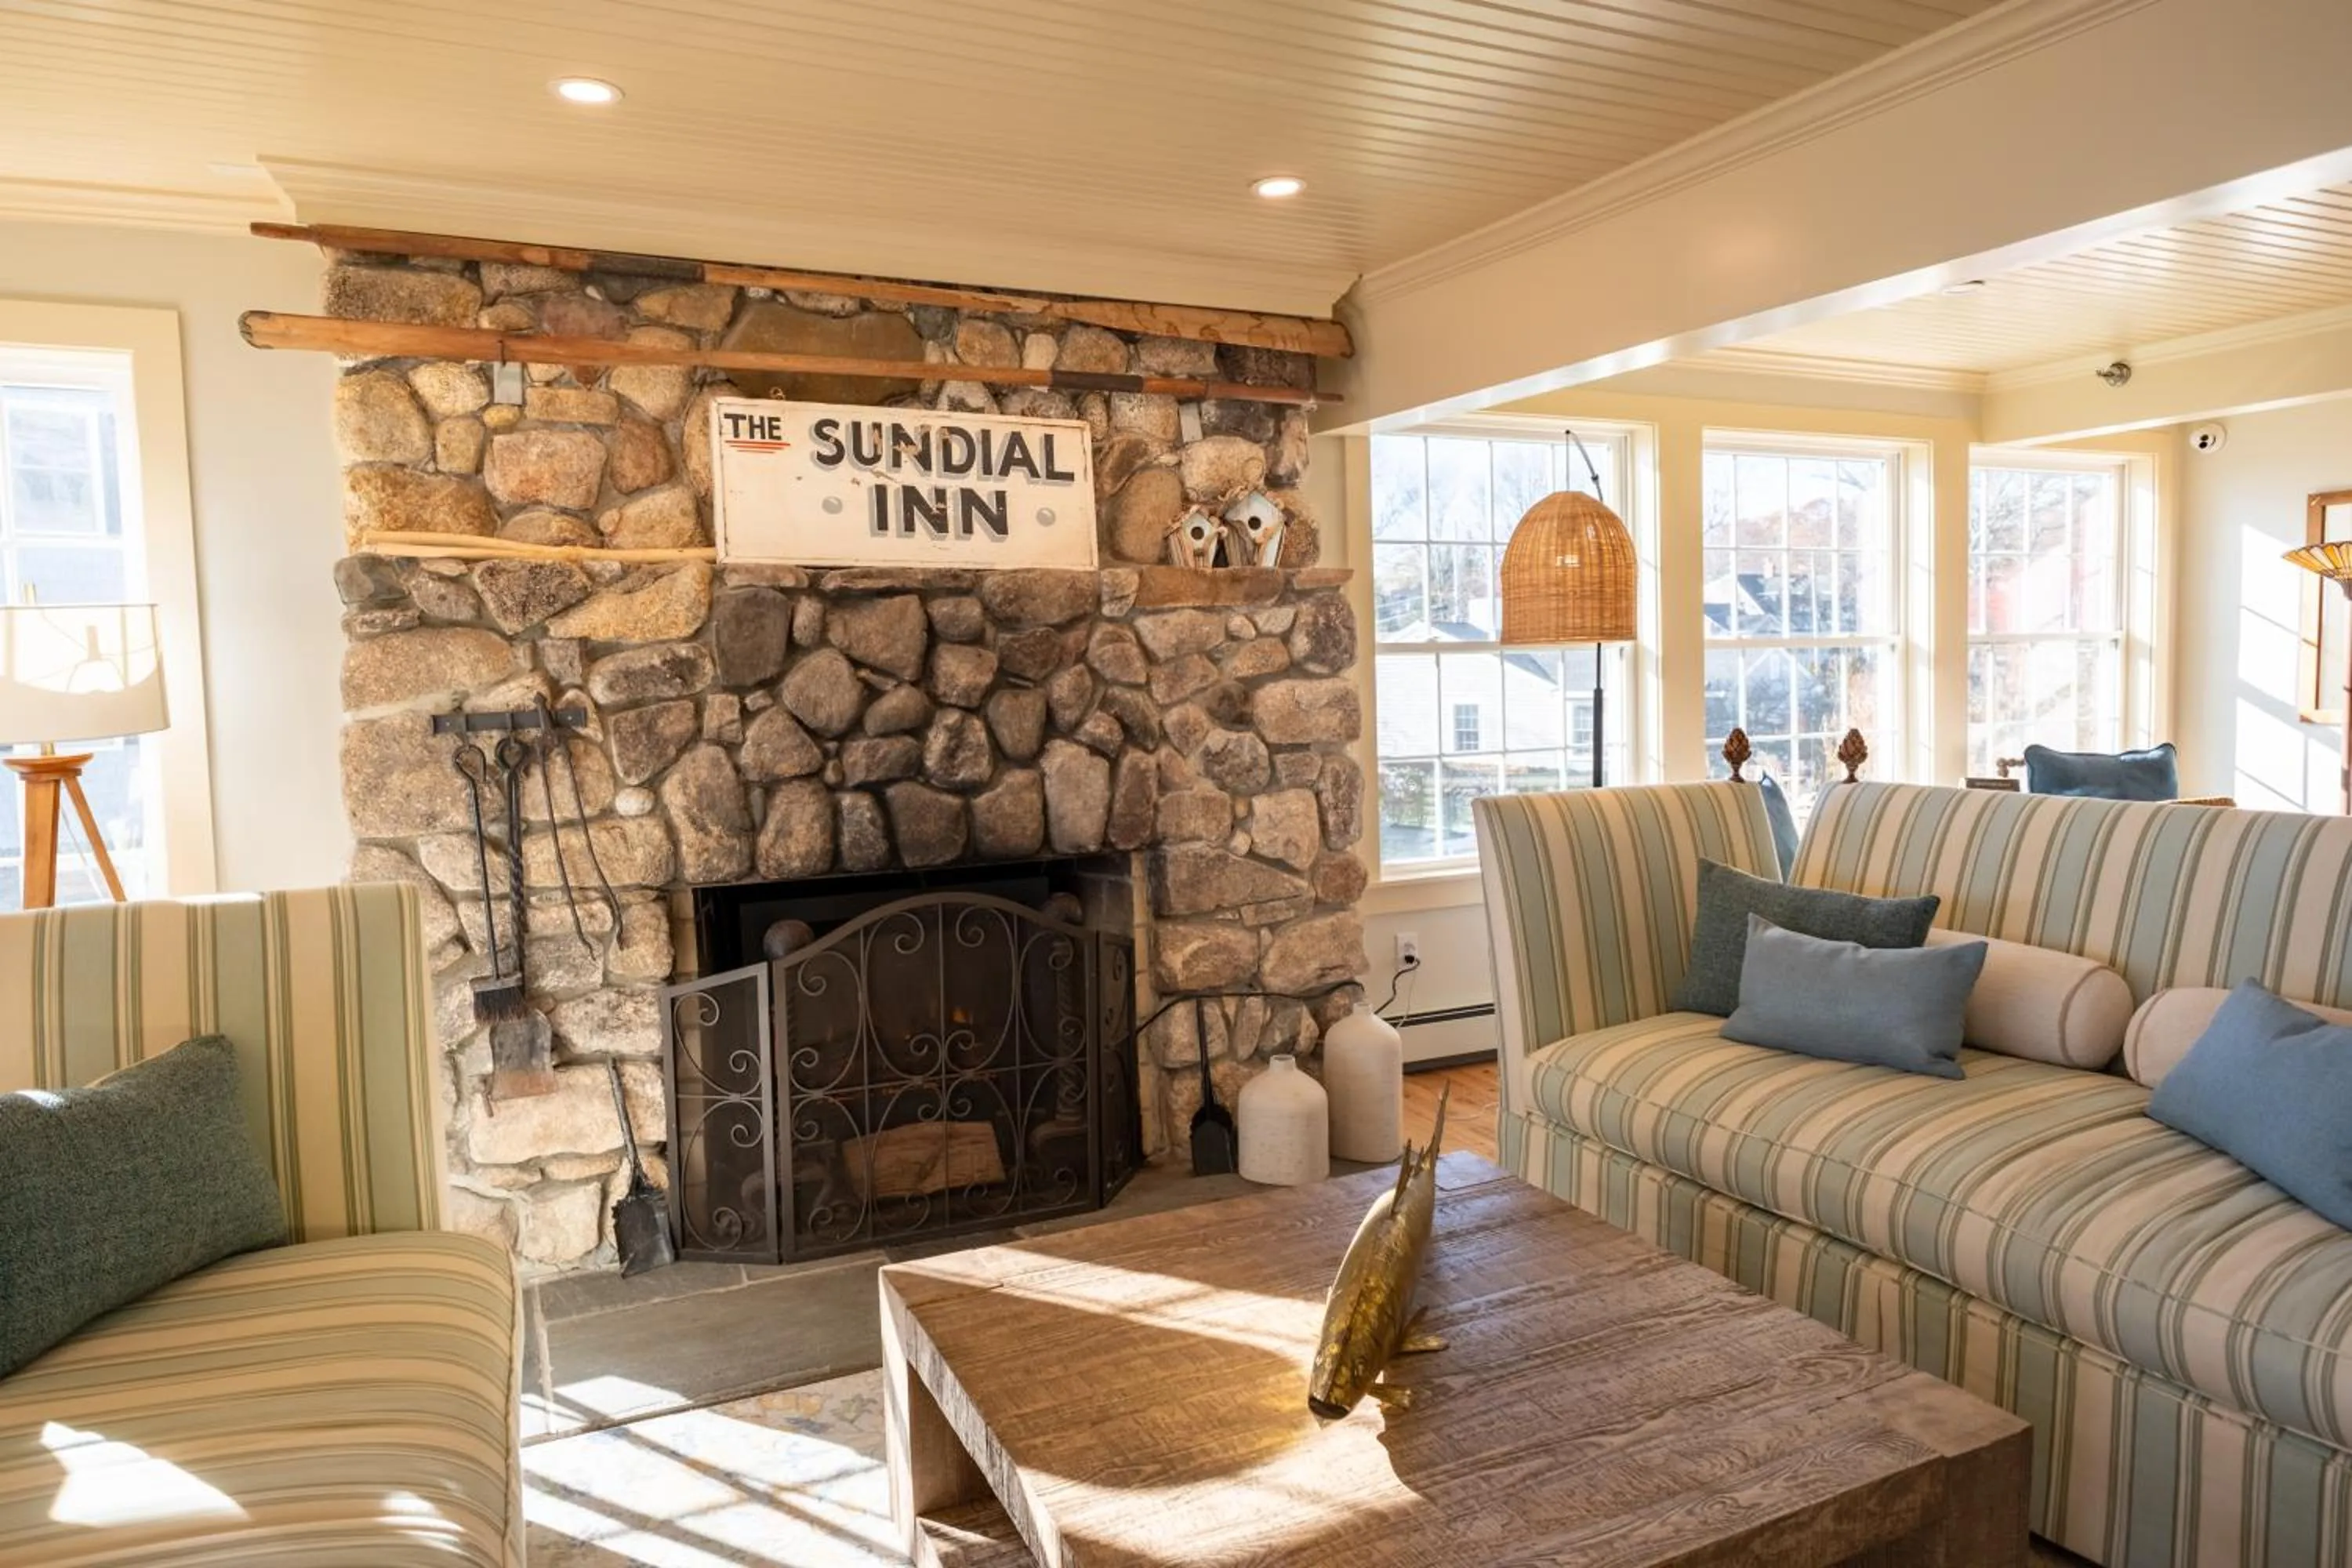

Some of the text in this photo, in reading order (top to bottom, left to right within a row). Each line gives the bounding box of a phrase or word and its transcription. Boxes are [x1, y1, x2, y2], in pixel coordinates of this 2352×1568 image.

[724, 413, 1075, 482] THE SUNDIAL
[872, 484, 1009, 537] INN
